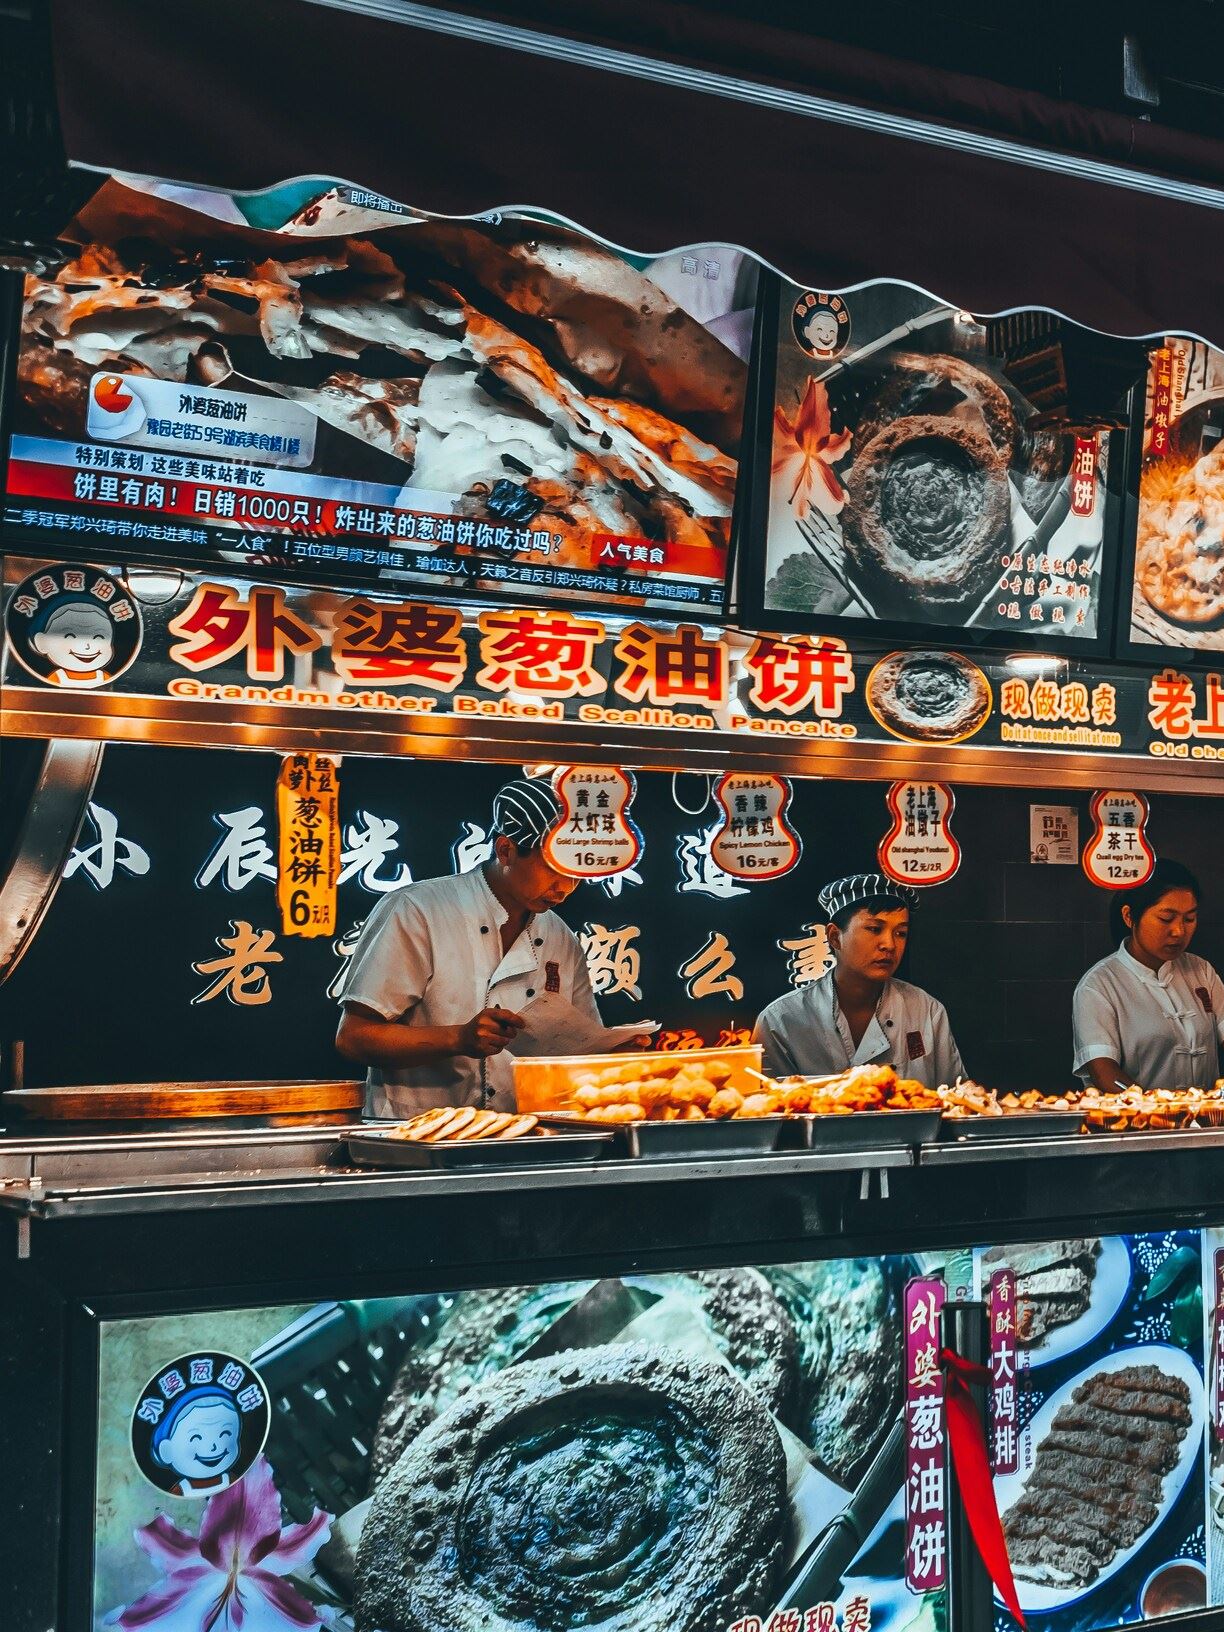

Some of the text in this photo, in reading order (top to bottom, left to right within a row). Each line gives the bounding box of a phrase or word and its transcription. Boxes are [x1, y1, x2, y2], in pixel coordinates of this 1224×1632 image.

[1155, 347, 1172, 450] 老上海油墩子
[1073, 436, 1096, 510] 油饼
[600, 541, 665, 565] 人气美食
[168, 582, 855, 717] 外婆葱油饼
[168, 678, 859, 739] Grandmother Baked Scallion Pancake
[1001, 678, 1116, 725] 现做现卖
[1001, 723, 1013, 741] Do
[1022, 726, 1032, 742] at
[1033, 728, 1051, 743] once
[1052, 727, 1068, 744] and
[1101, 731, 1121, 747] once
[1150, 741, 1189, 757] Old
[576, 789, 610, 808] 黄金
[734, 794, 768, 812] 香辣
[906, 785, 936, 809] 老上海
[570, 812, 615, 834] 大虾球
[730, 816, 775, 837] 柠檬鸡
[1108, 811, 1136, 828] 五香
[284, 796, 327, 888] 葱油饼
[719, 842, 738, 850] Spicy
[740, 841, 763, 849] Lemon
[1107, 831, 1137, 850] 茶干
[574, 852, 619, 866] 16元/客
[736, 854, 780, 868] 16元/客
[902, 860, 942, 872] 12元/2只
[1107, 866, 1139, 878] 12元/客
[993, 1275, 1017, 1466] 香酥大鸡排
[137, 1359, 264, 1424] 外婆葱油饼
[908, 1290, 946, 1580] 外婆葱油饼
[1024, 1434, 1033, 1470] steak
